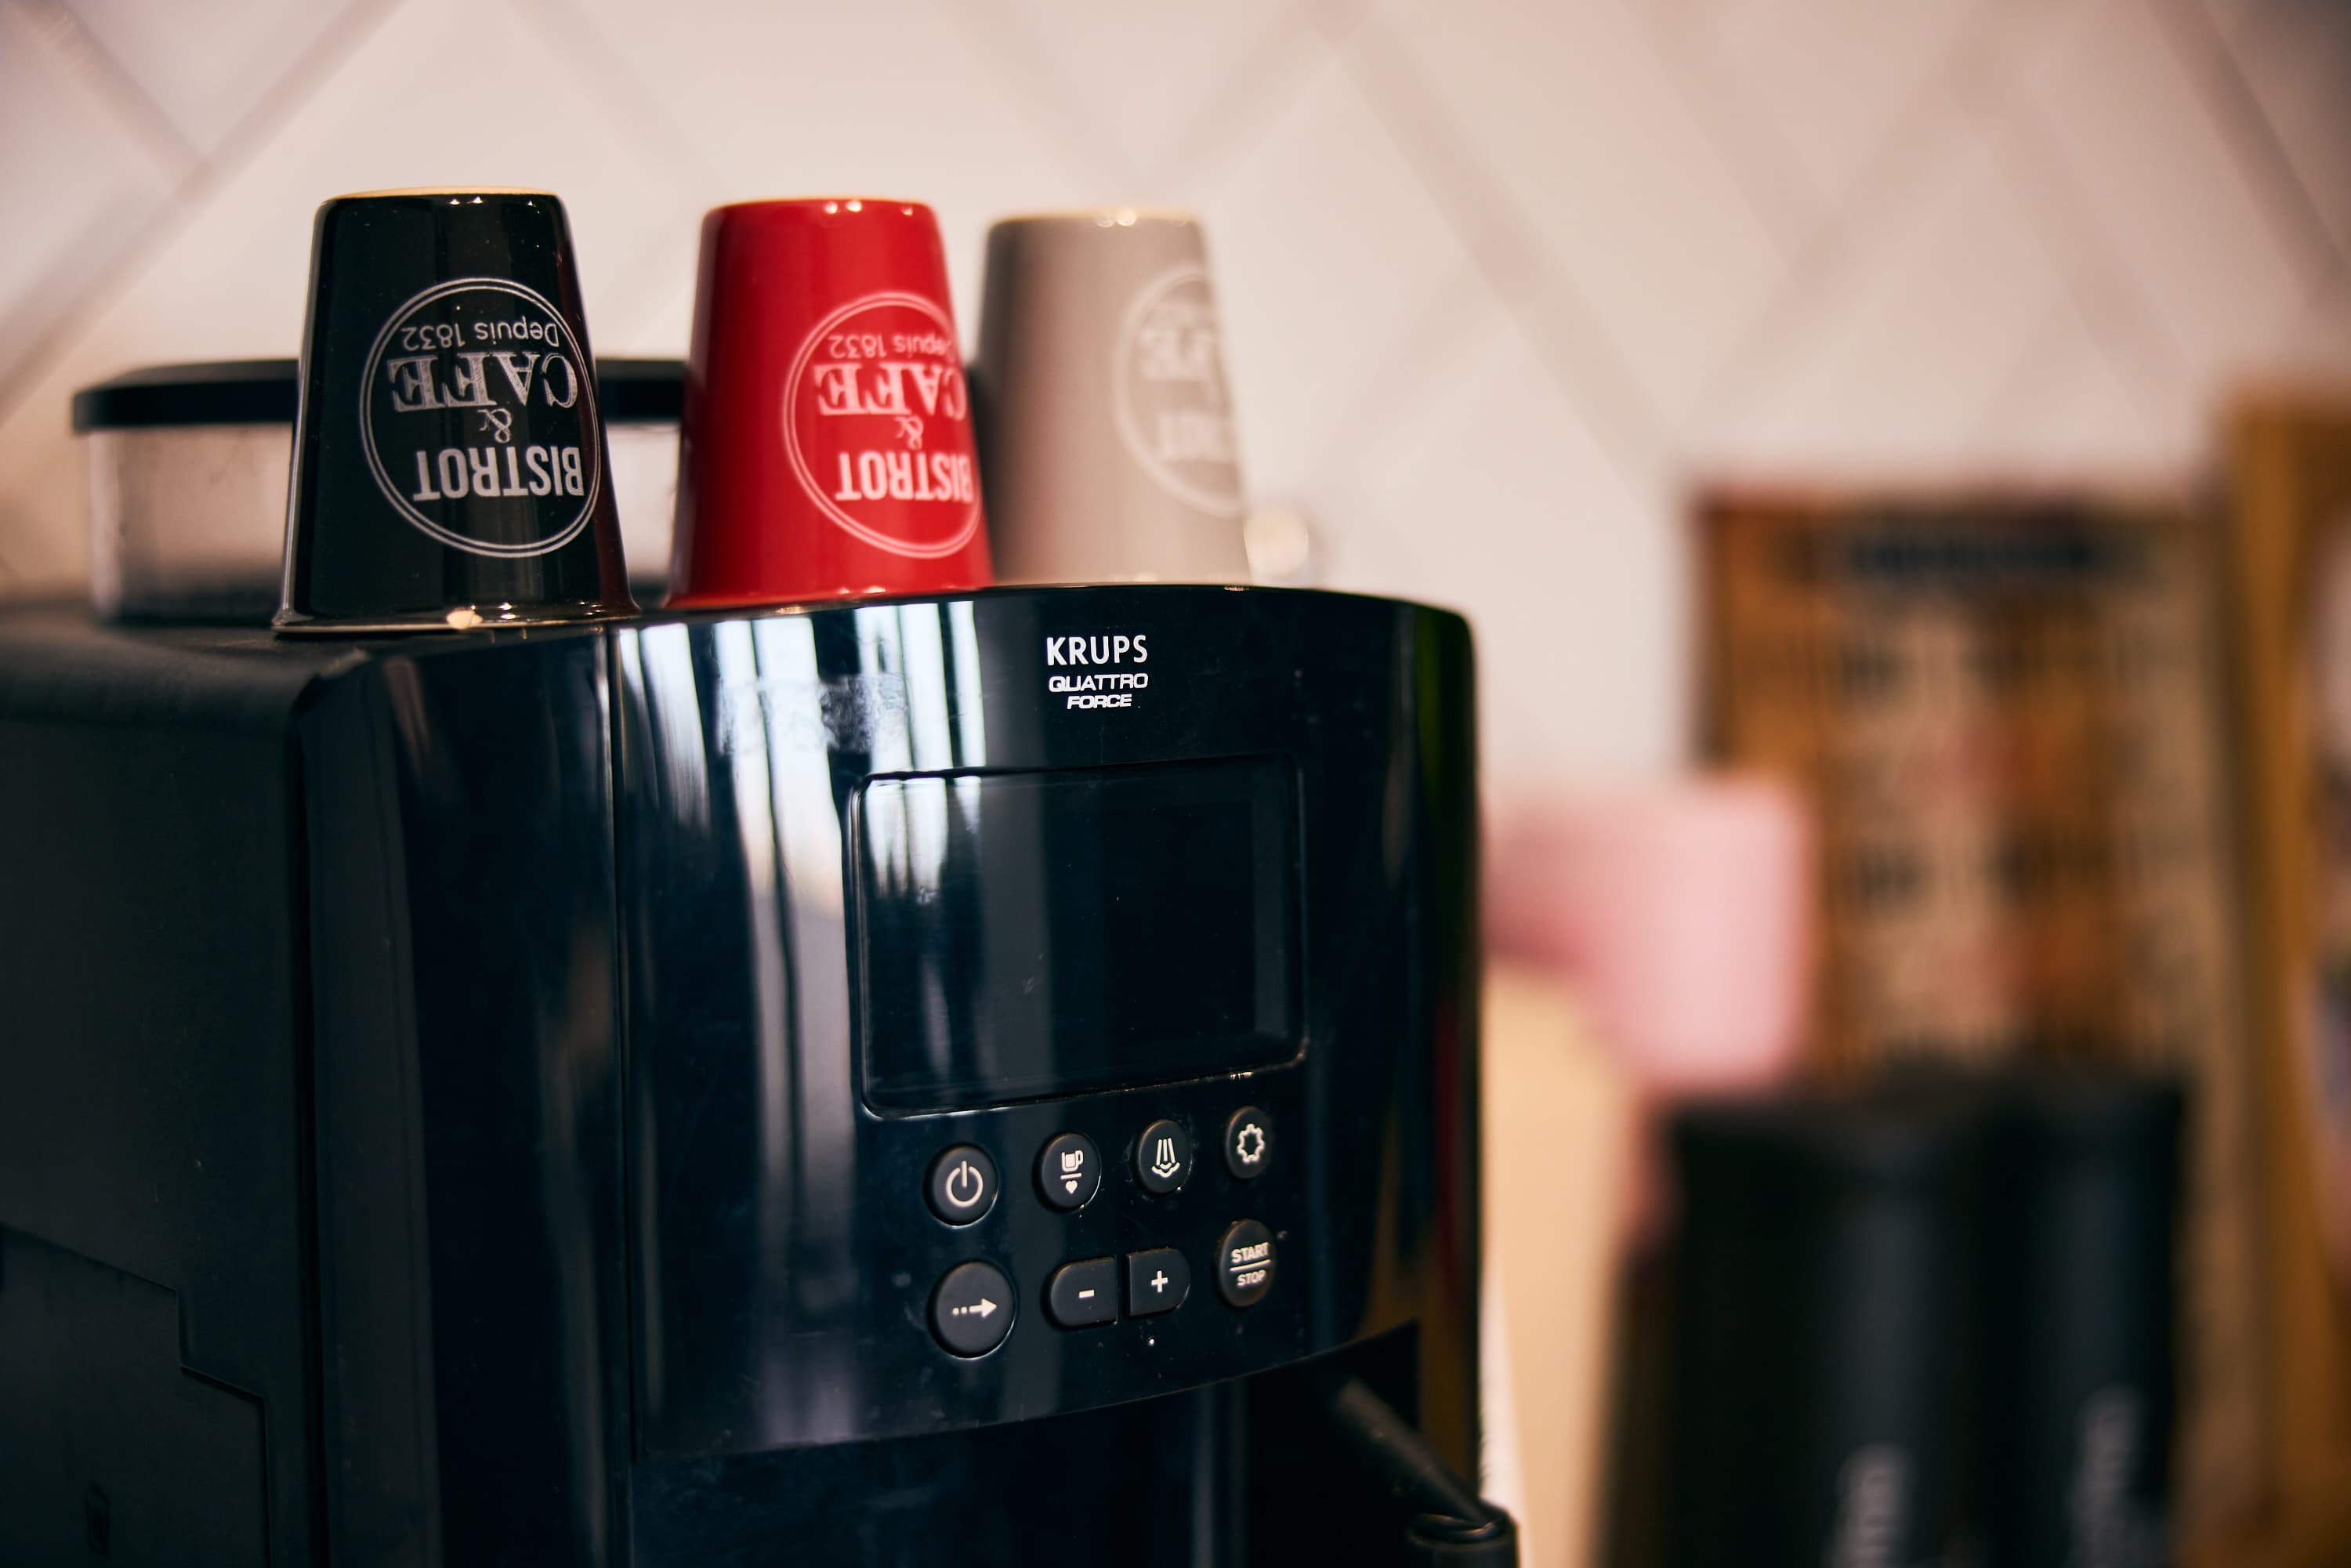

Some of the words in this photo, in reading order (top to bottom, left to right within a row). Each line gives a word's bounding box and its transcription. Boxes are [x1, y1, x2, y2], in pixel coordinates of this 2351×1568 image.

[401, 322, 465, 351] 1832
[475, 316, 560, 347] Depuis
[828, 333, 887, 359] 1832
[387, 351, 578, 413] CAFE
[813, 362, 968, 422] CAFE
[477, 407, 514, 444] &
[893, 416, 925, 450] &
[413, 446, 585, 502] BISTROT
[835, 451, 974, 504] BISTROT
[1046, 635, 1148, 666] KRUPS
[1049, 673, 1149, 693] QUATTRO
[1067, 693, 1132, 710] FORCE
[1230, 1241, 1270, 1263] START
[1237, 1269, 1266, 1287] STOP
